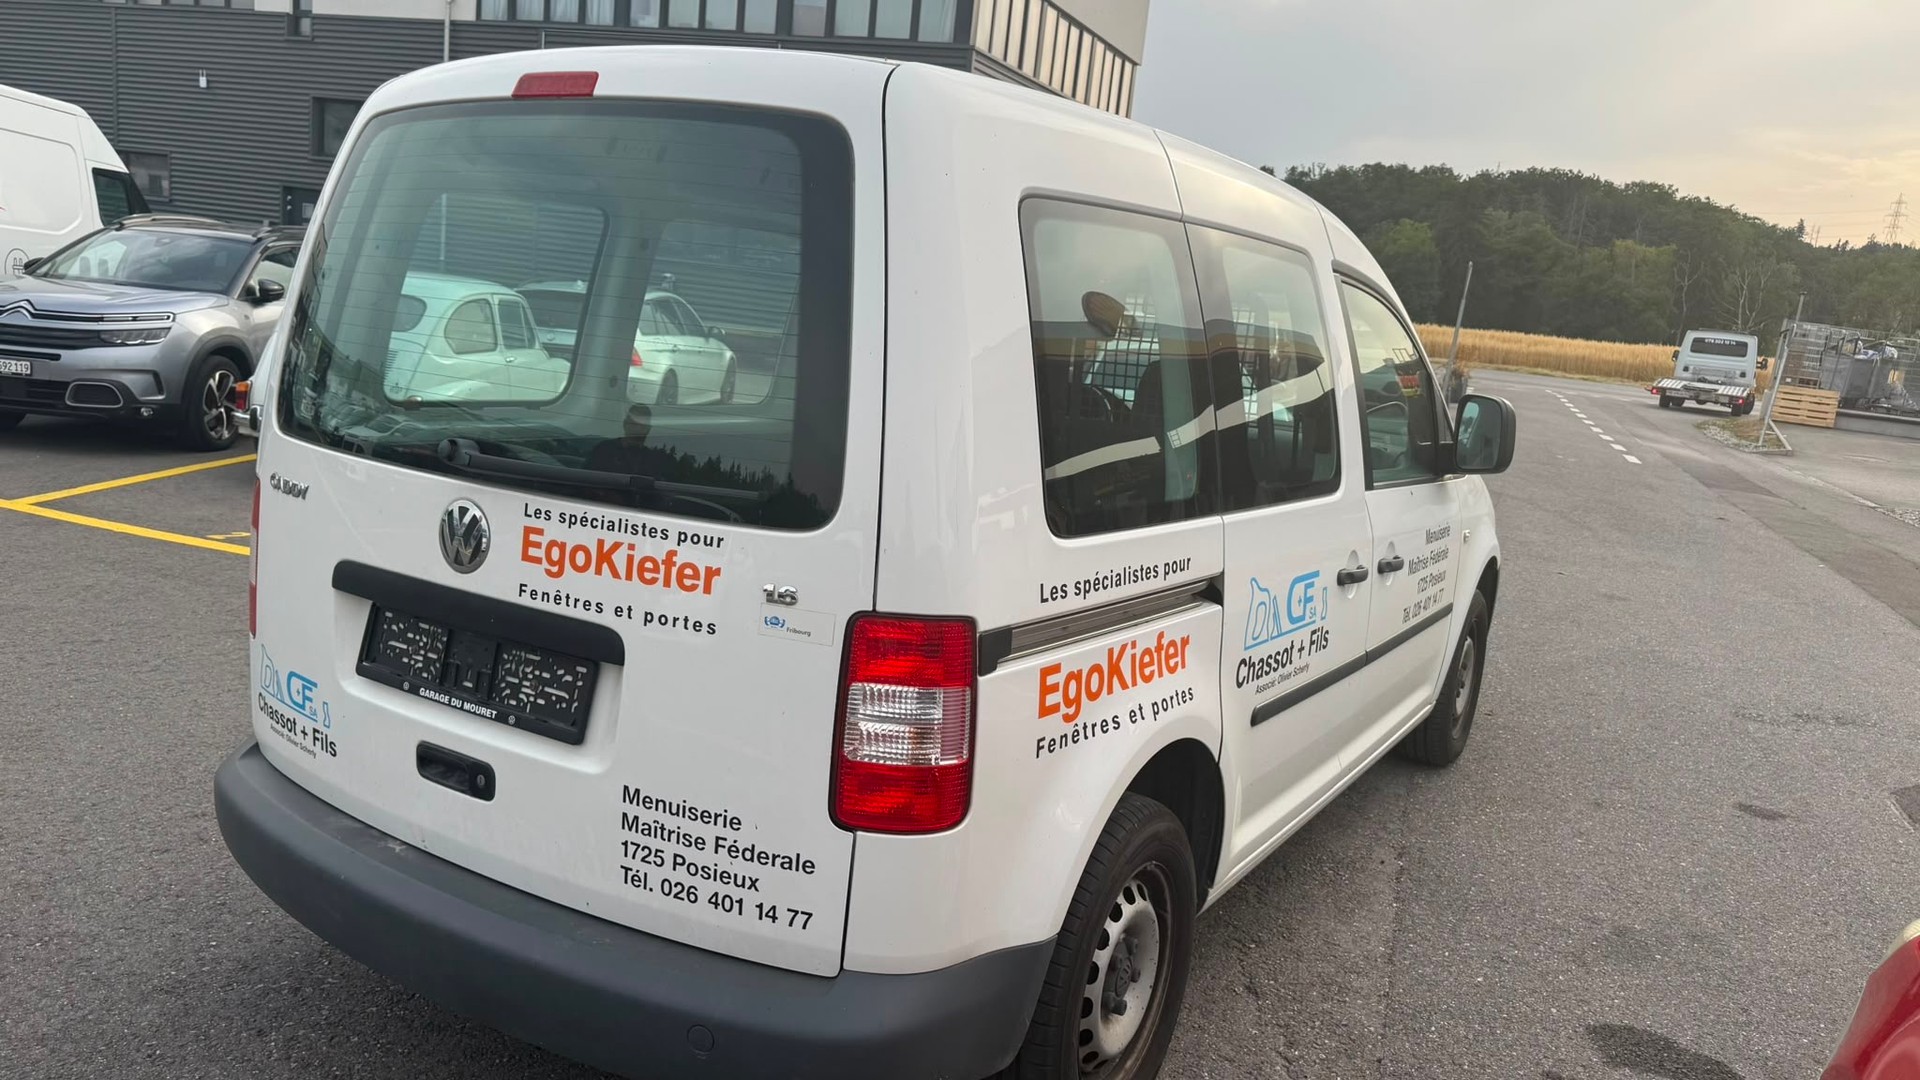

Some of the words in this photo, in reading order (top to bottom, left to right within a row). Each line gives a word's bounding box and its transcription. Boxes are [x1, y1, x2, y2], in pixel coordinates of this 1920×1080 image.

[270, 473, 309, 500] CADDY
[524, 502, 552, 521] Les
[558, 511, 670, 541] spécialistes
[677, 530, 725, 548] pour
[1425, 521, 1451, 545] Menuiserie
[521, 525, 721, 595] EgoKiefer
[1039, 582, 1068, 604] Les
[1074, 563, 1160, 600] spécialistes
[1163, 557, 1191, 581] pour
[518, 583, 604, 614] Fenêtres
[614, 604, 633, 620] et
[643, 610, 717, 635] portes
[786, 627, 812, 638] Fribourg
[1037, 630, 1191, 724] EgoKiefer
[1235, 640, 1294, 689] Chassot
[1297, 639, 1305, 660] +
[1308, 626, 1329, 656] Fils
[1277, 671, 1293, 685] Olivier
[1292, 661, 1311, 678] Scherly
[258, 691, 298, 737] Chassot
[300, 725, 309, 741] +
[312, 727, 337, 758] Fils
[419, 687, 450, 704] GARAGE
[450, 697, 462, 709] DU
[463, 701, 497, 719] MOURET
[1036, 714, 1121, 759] Fenêtres
[1129, 703, 1146, 725] et
[1152, 687, 1194, 721] portes
[622, 784, 743, 832] Menuiserie
[621, 811, 707, 852] Maîtrise
[714, 835, 817, 876] Féderale
[621, 840, 665, 868] 1725
[672, 852, 760, 893] Posieux
[620, 865, 654, 893] Tél.
[660, 878, 699, 904] 026
[707, 891, 744, 916] 401
[755, 902, 779, 924] 14
[786, 907, 814, 930] 77
